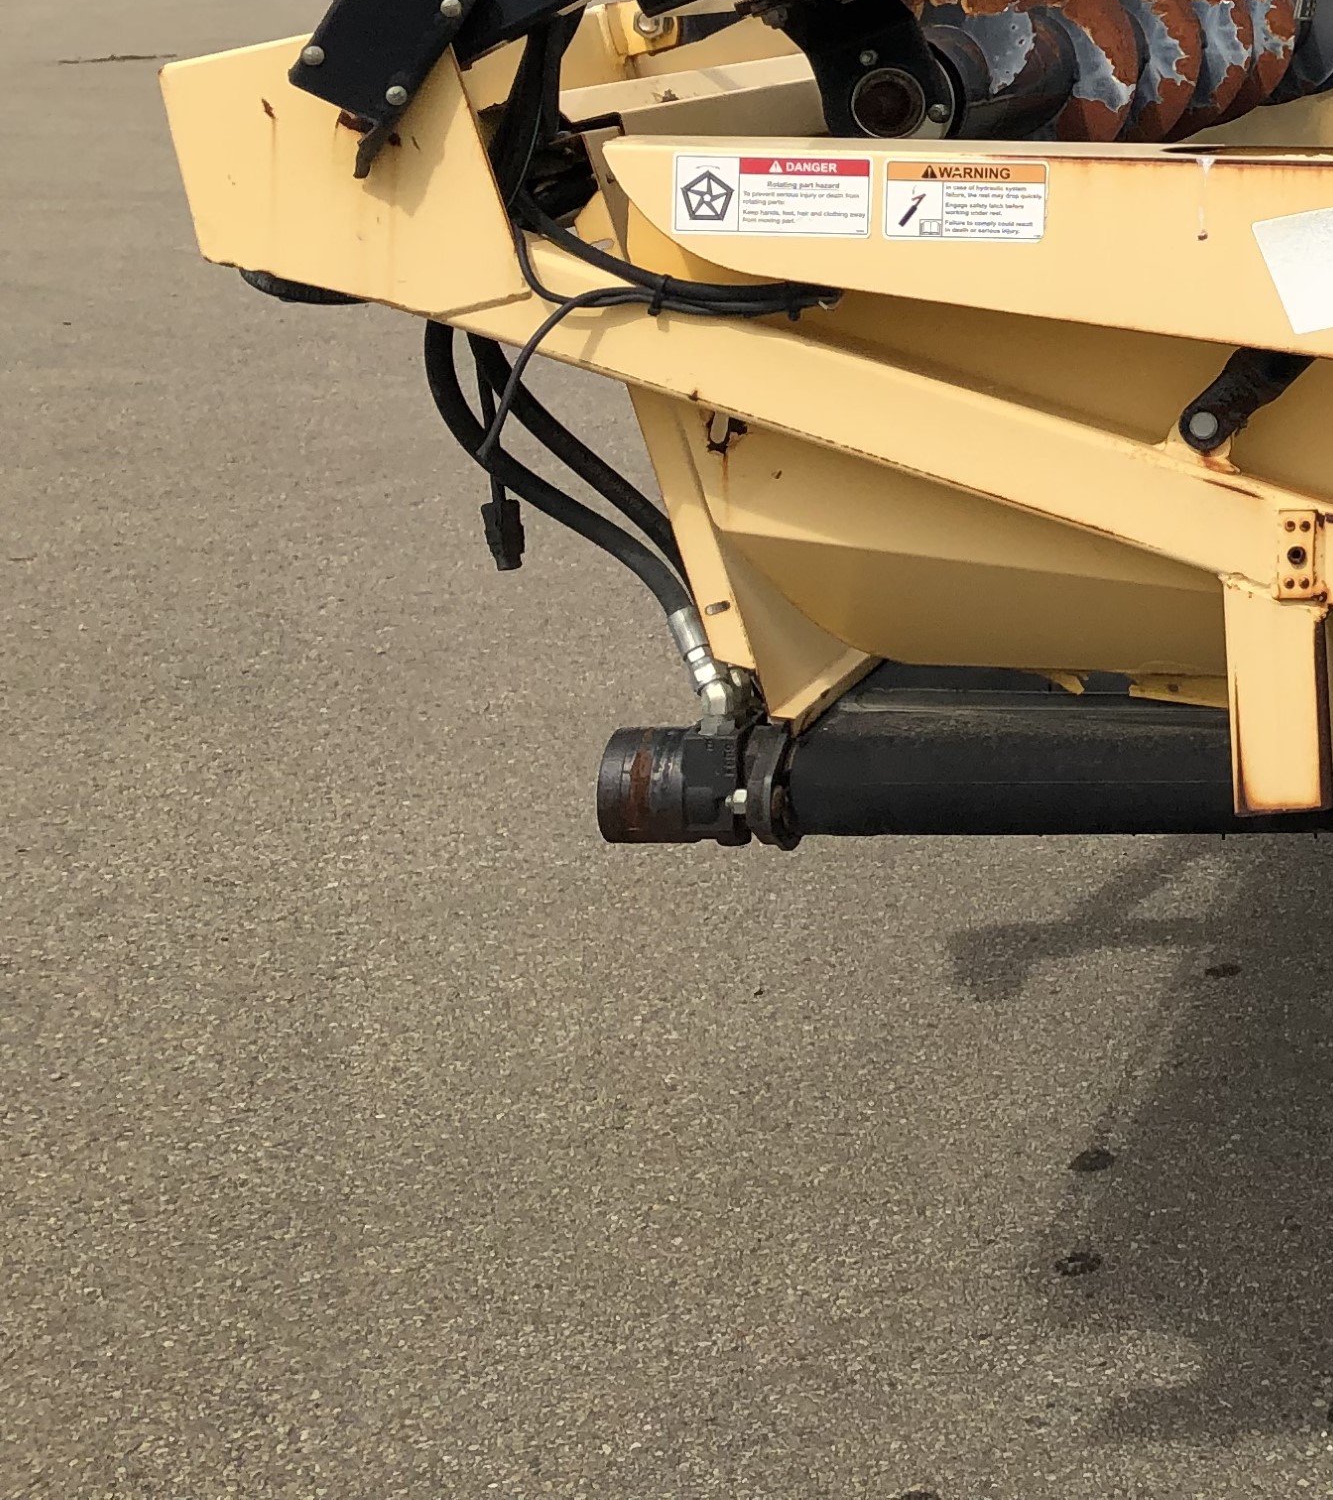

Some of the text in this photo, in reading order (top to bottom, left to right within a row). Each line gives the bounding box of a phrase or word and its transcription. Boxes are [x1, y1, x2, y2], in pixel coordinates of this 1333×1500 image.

[786, 161, 838, 173] DANGER
[938, 166, 1011, 180] WARNING
[767, 181, 797, 190] Rotating
[799, 182, 814, 190] part
